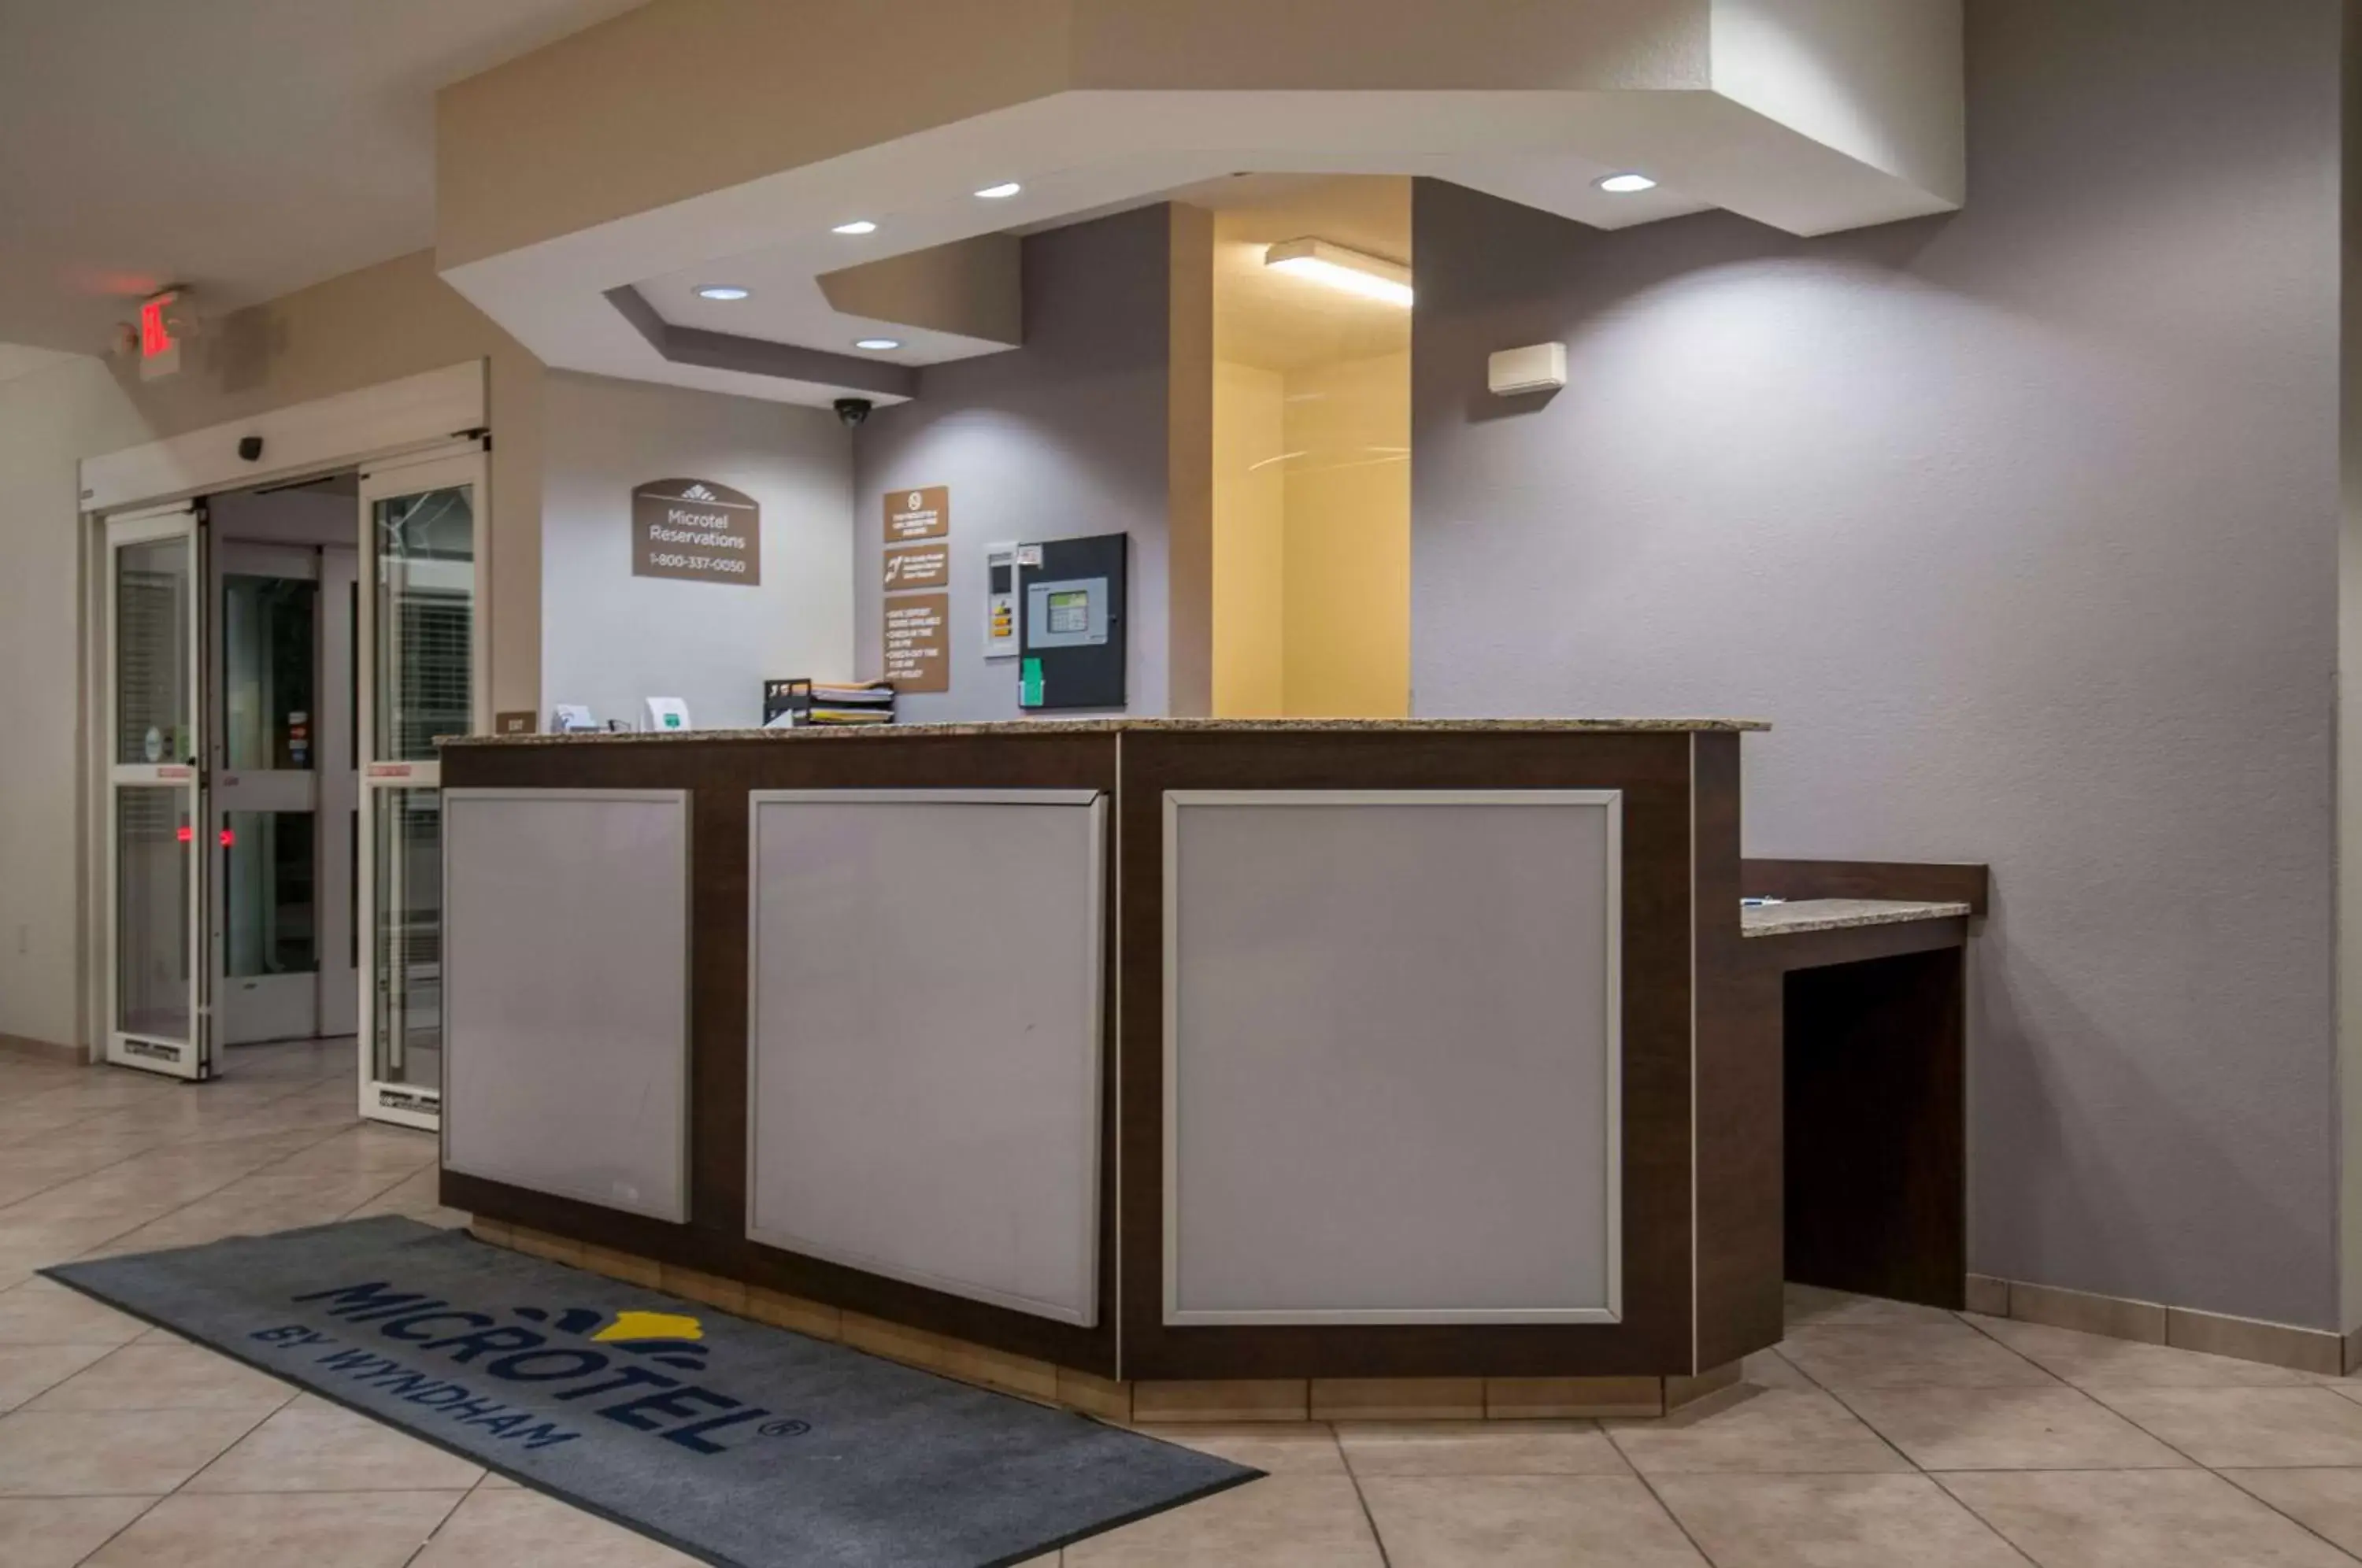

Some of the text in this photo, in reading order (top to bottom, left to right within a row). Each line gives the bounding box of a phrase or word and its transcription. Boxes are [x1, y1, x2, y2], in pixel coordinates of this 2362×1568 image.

[668, 508, 729, 529] Microtel
[649, 524, 746, 549] Reservations
[649, 552, 746, 574] 1-800-337-0050
[291, 1281, 772, 1455] MICROTEL
[249, 1324, 583, 1450] BY WYNDHAM
